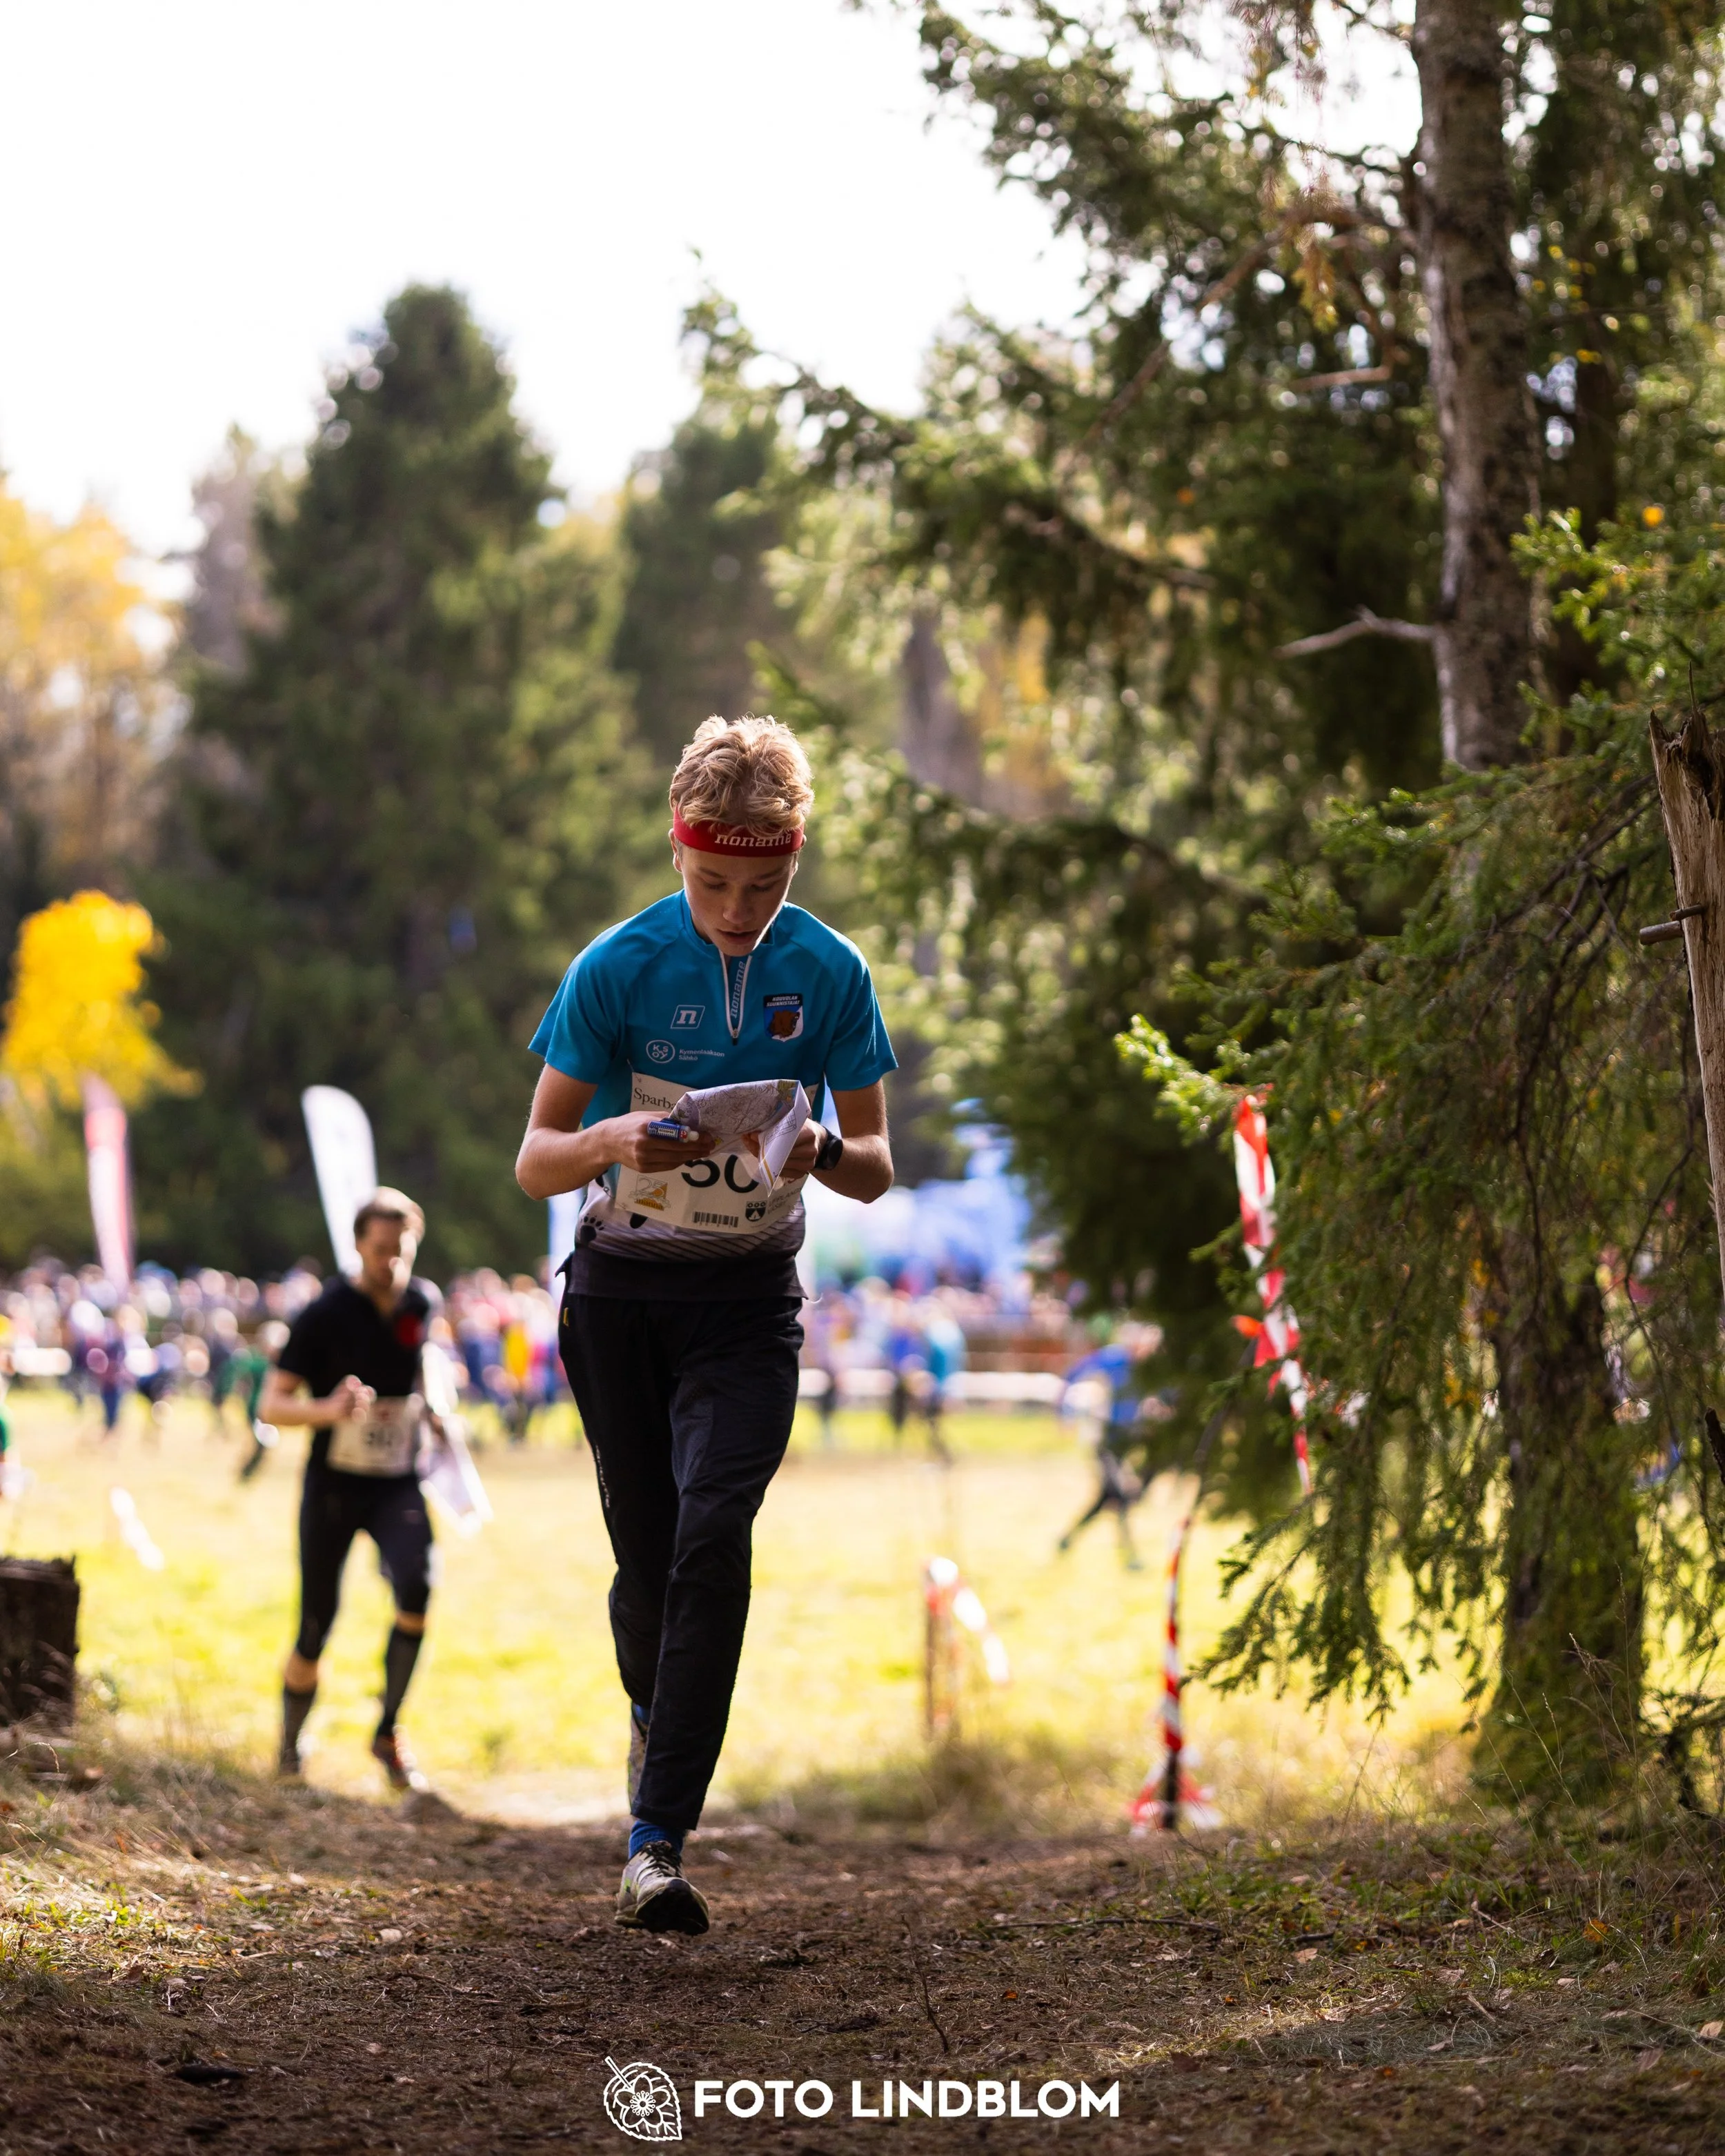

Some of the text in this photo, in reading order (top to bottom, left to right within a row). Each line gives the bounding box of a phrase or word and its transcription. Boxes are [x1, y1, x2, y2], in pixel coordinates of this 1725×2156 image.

[715, 833, 791, 847] noname
[731, 960, 745, 1018] noname
[679, 1049, 724, 1057] Kymenlaakson
